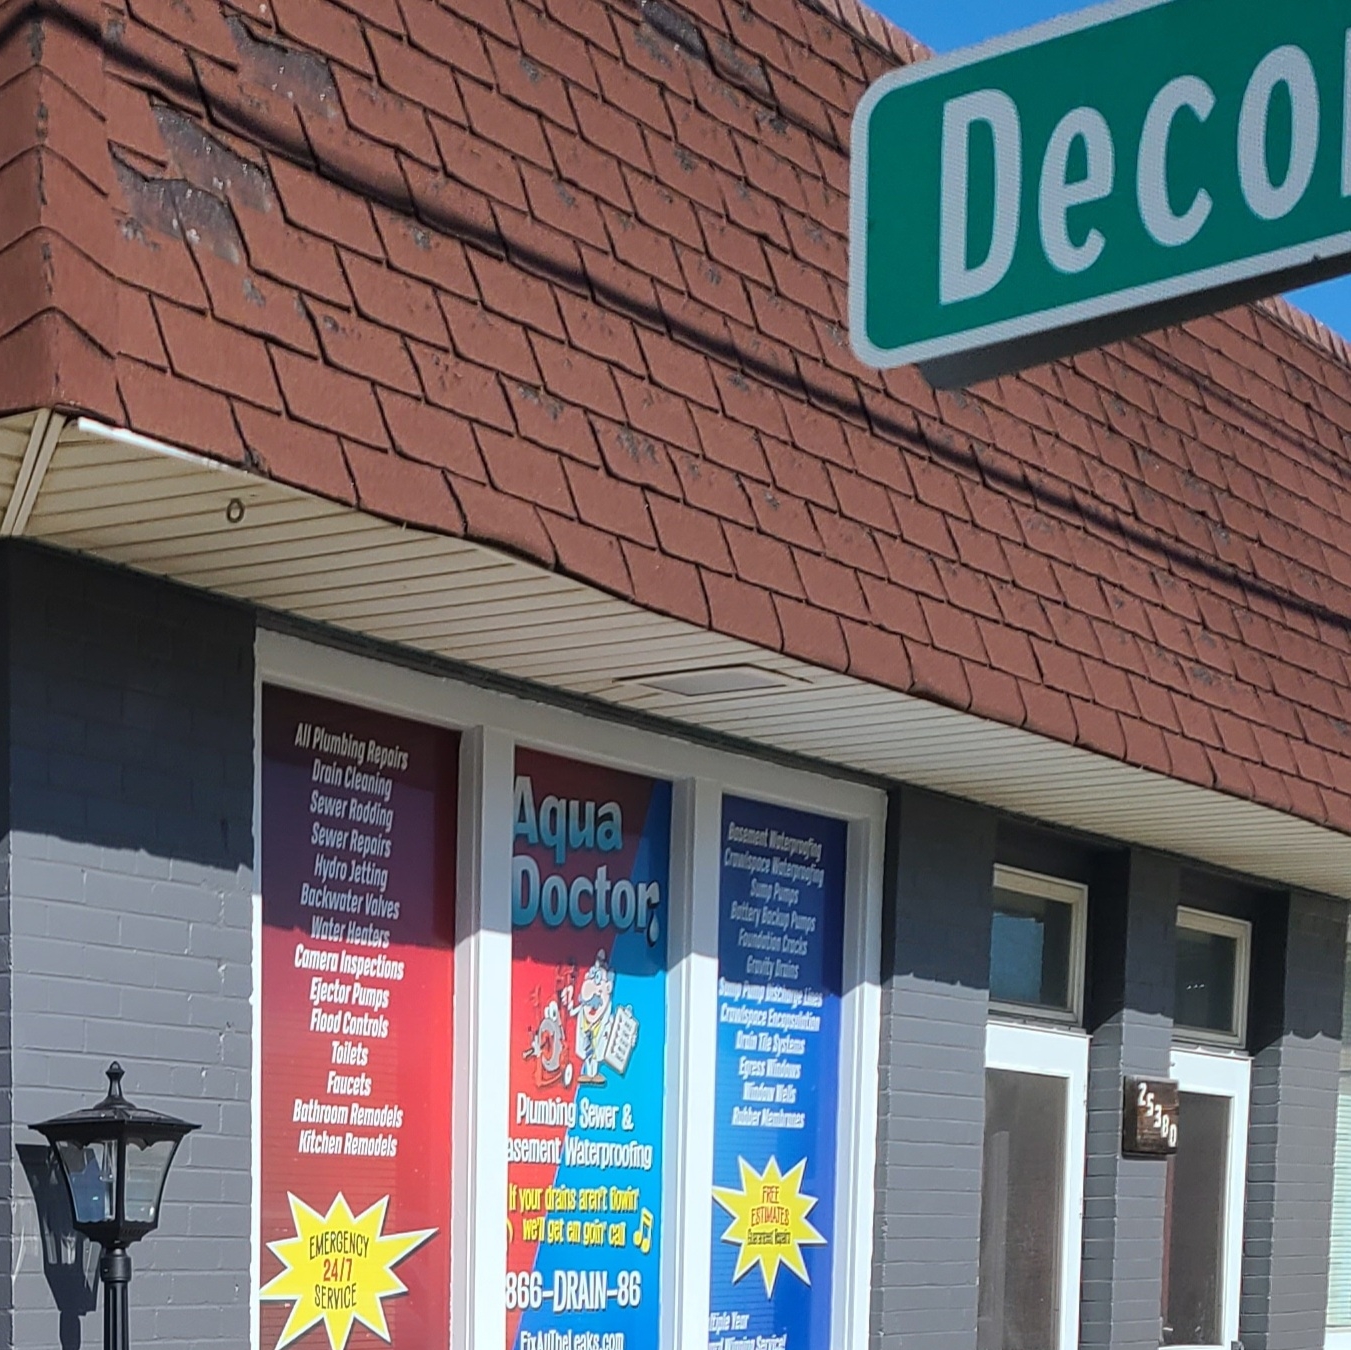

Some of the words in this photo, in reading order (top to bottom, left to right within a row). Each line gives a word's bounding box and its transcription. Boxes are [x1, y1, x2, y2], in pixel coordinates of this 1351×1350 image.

[939, 27, 1351, 305] Deco
[294, 722, 311, 748] All
[312, 726, 365, 766] Plumbing
[367, 740, 408, 770] Repairs
[312, 758, 342, 786] Drain
[344, 769, 393, 802] Cleaning
[310, 790, 347, 820] Sewer
[349, 797, 393, 833] Rodding
[513, 776, 622, 864] Aqua
[311, 822, 349, 850] Sewer
[350, 829, 392, 859] Repairs
[314, 853, 347, 884] Hydro
[348, 860, 388, 893] Jetting
[301, 882, 364, 914] Backwater
[365, 893, 400, 920] Valves
[512, 855, 660, 929] Doctor
[311, 915, 346, 942] Water
[346, 921, 390, 949] Heaters
[294, 943, 339, 972] Camera
[340, 949, 405, 980] Inspections
[310, 976, 352, 1006] Ejector
[352, 982, 390, 1012] Pumps
[310, 1007, 342, 1034] Flood
[342, 1011, 389, 1038] Controls
[331, 1040, 369, 1066] Toilets
[772, 1033, 806, 1058] Systems
[327, 1070, 371, 1096] Faucets
[738, 1055, 766, 1080] Egress
[292, 1098, 349, 1124] Bathroom
[349, 1102, 404, 1128] Remodels
[517, 1093, 576, 1129] Plumbing
[579, 1097, 619, 1130] Sewer
[622, 1104, 634, 1130] &
[298, 1129, 343, 1155] Kitchen
[344, 1132, 398, 1157] Remodels
[507, 1137, 561, 1164] asement
[565, 1135, 653, 1170] Waterproofing
[509, 1183, 517, 1211] If
[518, 1188, 543, 1213] your
[545, 1184, 576, 1211] drains
[579, 1186, 608, 1211] aren't
[763, 1185, 780, 1204] FREE
[523, 1217, 545, 1241] we'll
[548, 1218, 564, 1243] get
[567, 1221, 580, 1243] em
[609, 1222, 626, 1246] call
[751, 1206, 789, 1227] ESTIMATES
[310, 1231, 370, 1260] EMERGENCY
[323, 1257, 352, 1282] 24/7
[315, 1282, 357, 1310] SERVICE
[506, 1270, 641, 1312] 866-DRAIN-86
